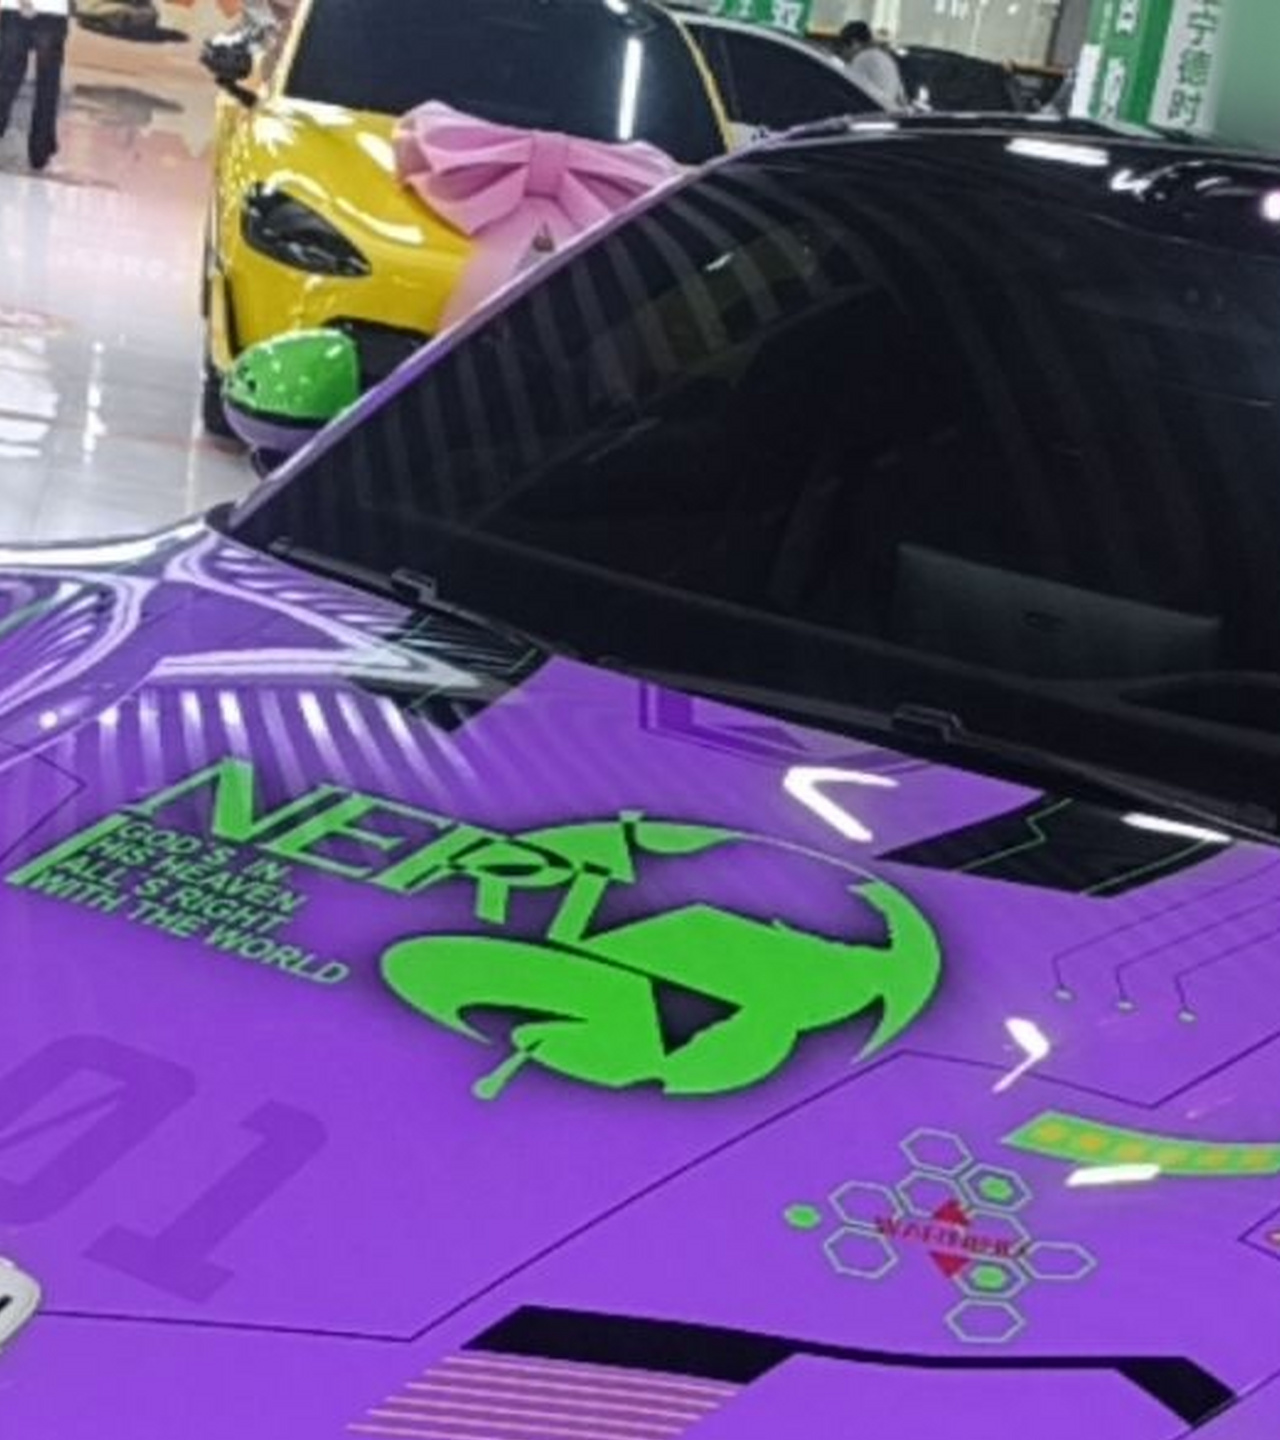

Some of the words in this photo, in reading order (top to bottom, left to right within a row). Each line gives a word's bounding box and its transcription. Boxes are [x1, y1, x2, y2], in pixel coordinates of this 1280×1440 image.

[91, 835, 154, 865] HIS
[151, 853, 308, 913] HEAVEN
[123, 755, 645, 940] NERV
[29, 872, 129, 913] WITH
[128, 899, 208, 938] THE
[204, 926, 350, 984] WORLD
[164, 884, 293, 934] RIGHT
